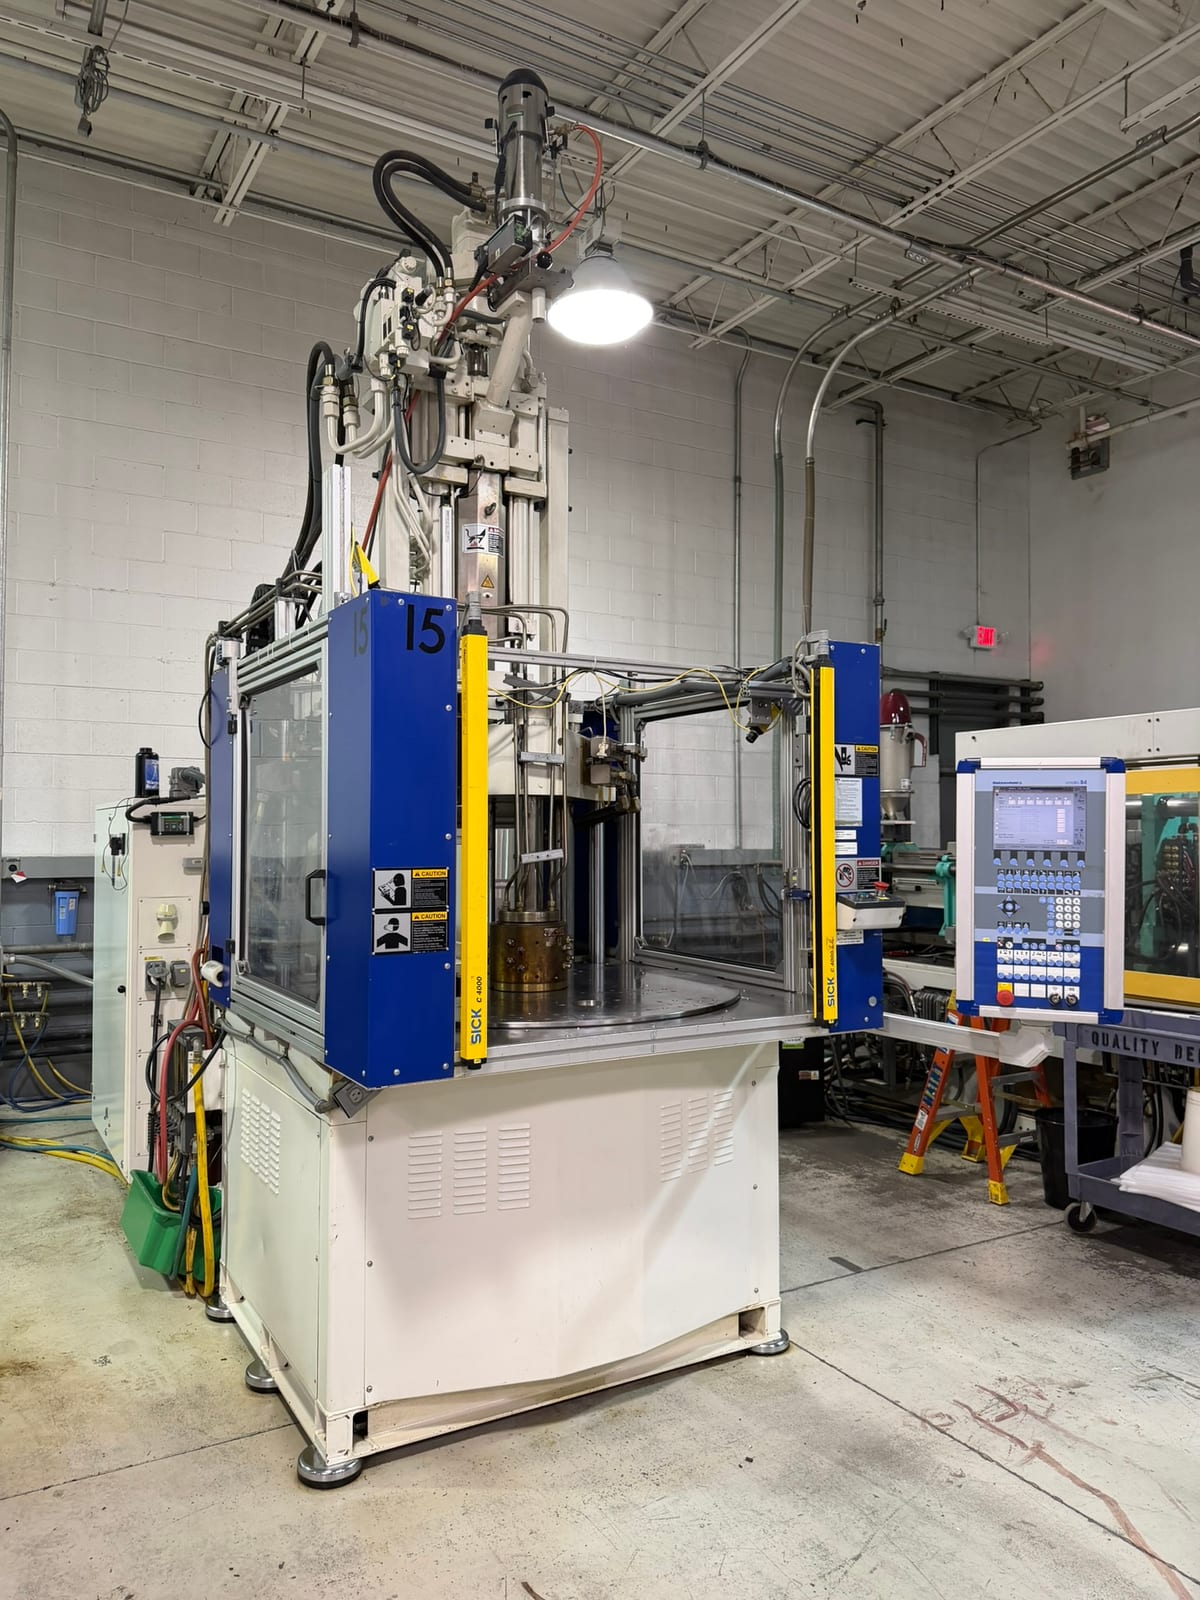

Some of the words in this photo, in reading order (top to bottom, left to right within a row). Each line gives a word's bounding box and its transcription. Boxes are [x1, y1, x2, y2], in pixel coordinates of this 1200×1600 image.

[406, 604, 445, 653] 15
[977, 626, 994, 646] EXIT
[827, 977, 835, 1007] SICK
[471, 1008, 482, 1044] SICK
[1091, 1031, 1159, 1056] QUALITY
